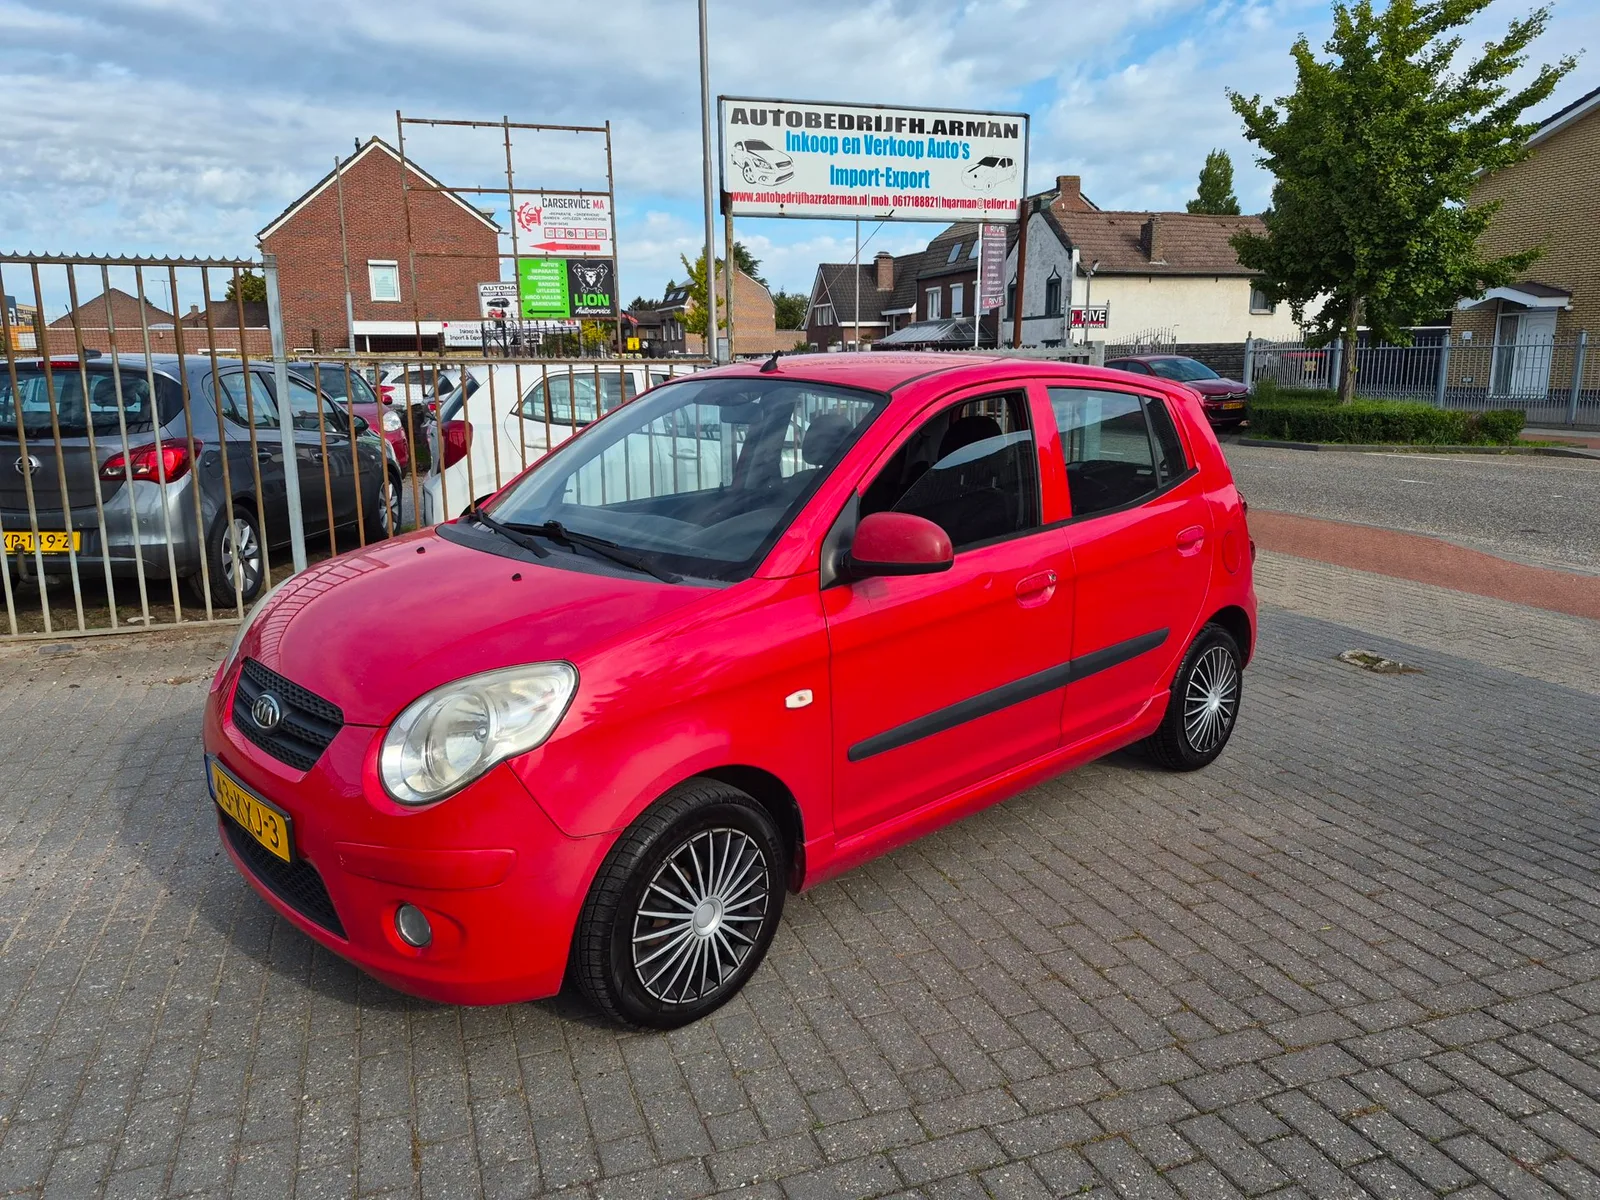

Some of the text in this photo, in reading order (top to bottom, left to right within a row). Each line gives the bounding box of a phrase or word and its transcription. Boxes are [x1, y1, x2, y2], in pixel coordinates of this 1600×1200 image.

[731, 107, 1018, 139] AUTOBEDRIJFH.ARMAN
[785, 130, 970, 160] Inkoop en Verkoop Auto's
[829, 164, 930, 190] Import-Export
[542, 197, 605, 209] CARSERVICE MA
[871, 195, 891, 207] mob.
[574, 293, 610, 307] LION
